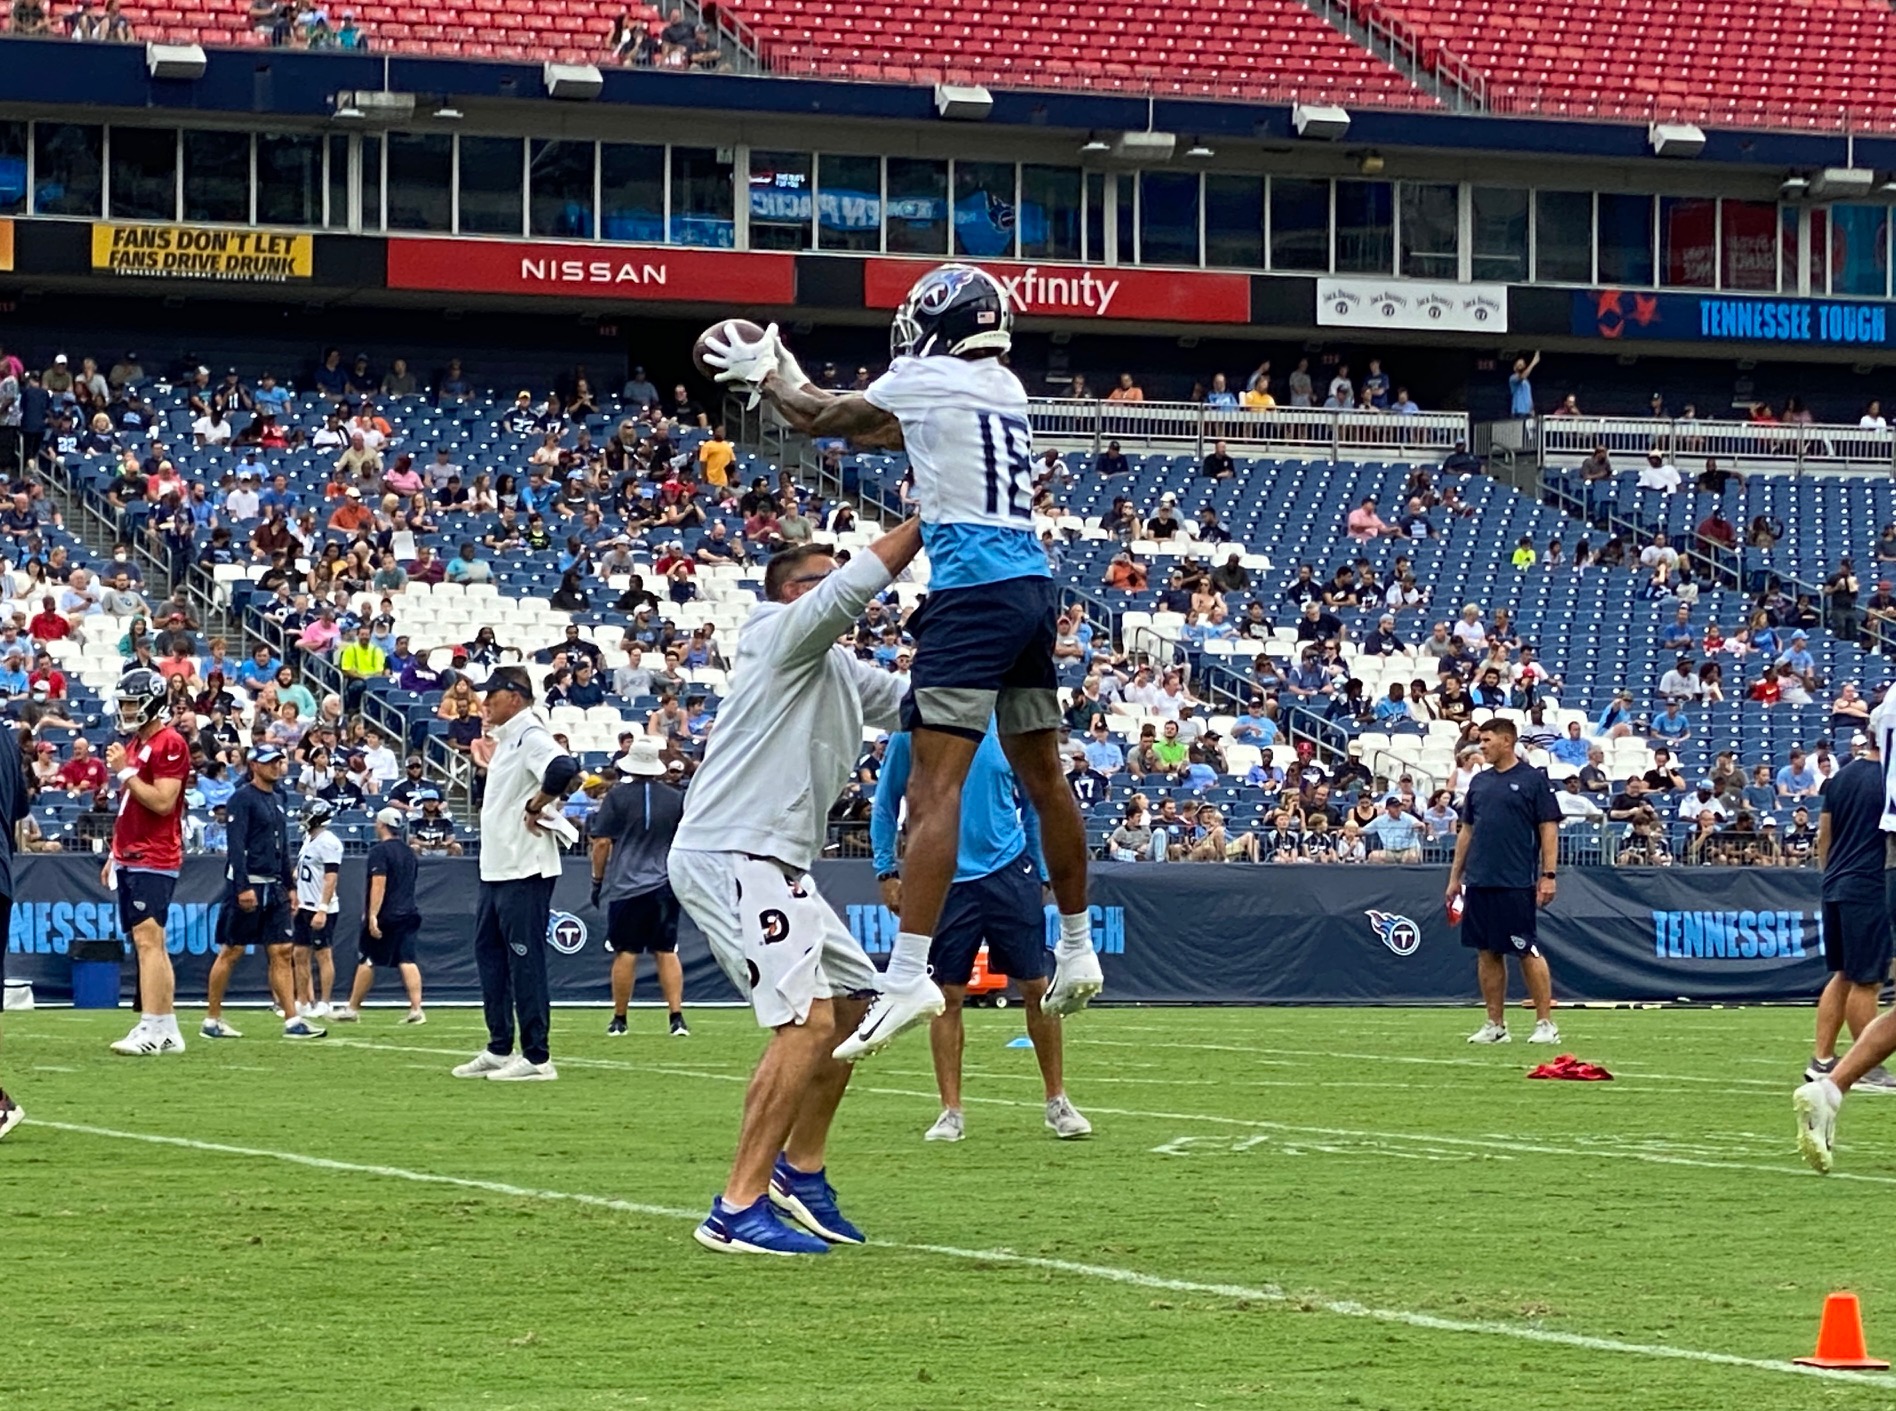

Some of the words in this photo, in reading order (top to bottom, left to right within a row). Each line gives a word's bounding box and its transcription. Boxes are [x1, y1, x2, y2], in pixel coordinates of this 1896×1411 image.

[112, 229, 172, 249] FANS
[177, 231, 249, 252] DON'T
[253, 234, 298, 254] LET
[109, 250, 159, 267] FANS
[163, 252, 220, 271] DRIVE
[225, 255, 296, 275] DRUNK
[521, 258, 666, 285] NISSAN
[1001, 267, 1120, 316] xfinity
[1700, 301, 1811, 339] TENNESSEE
[1818, 305, 1886, 343] TOUGH
[57, 436, 77, 453] 22
[1074, 778, 1094, 800] 17
[1652, 910, 1807, 959] TENNESSEE
